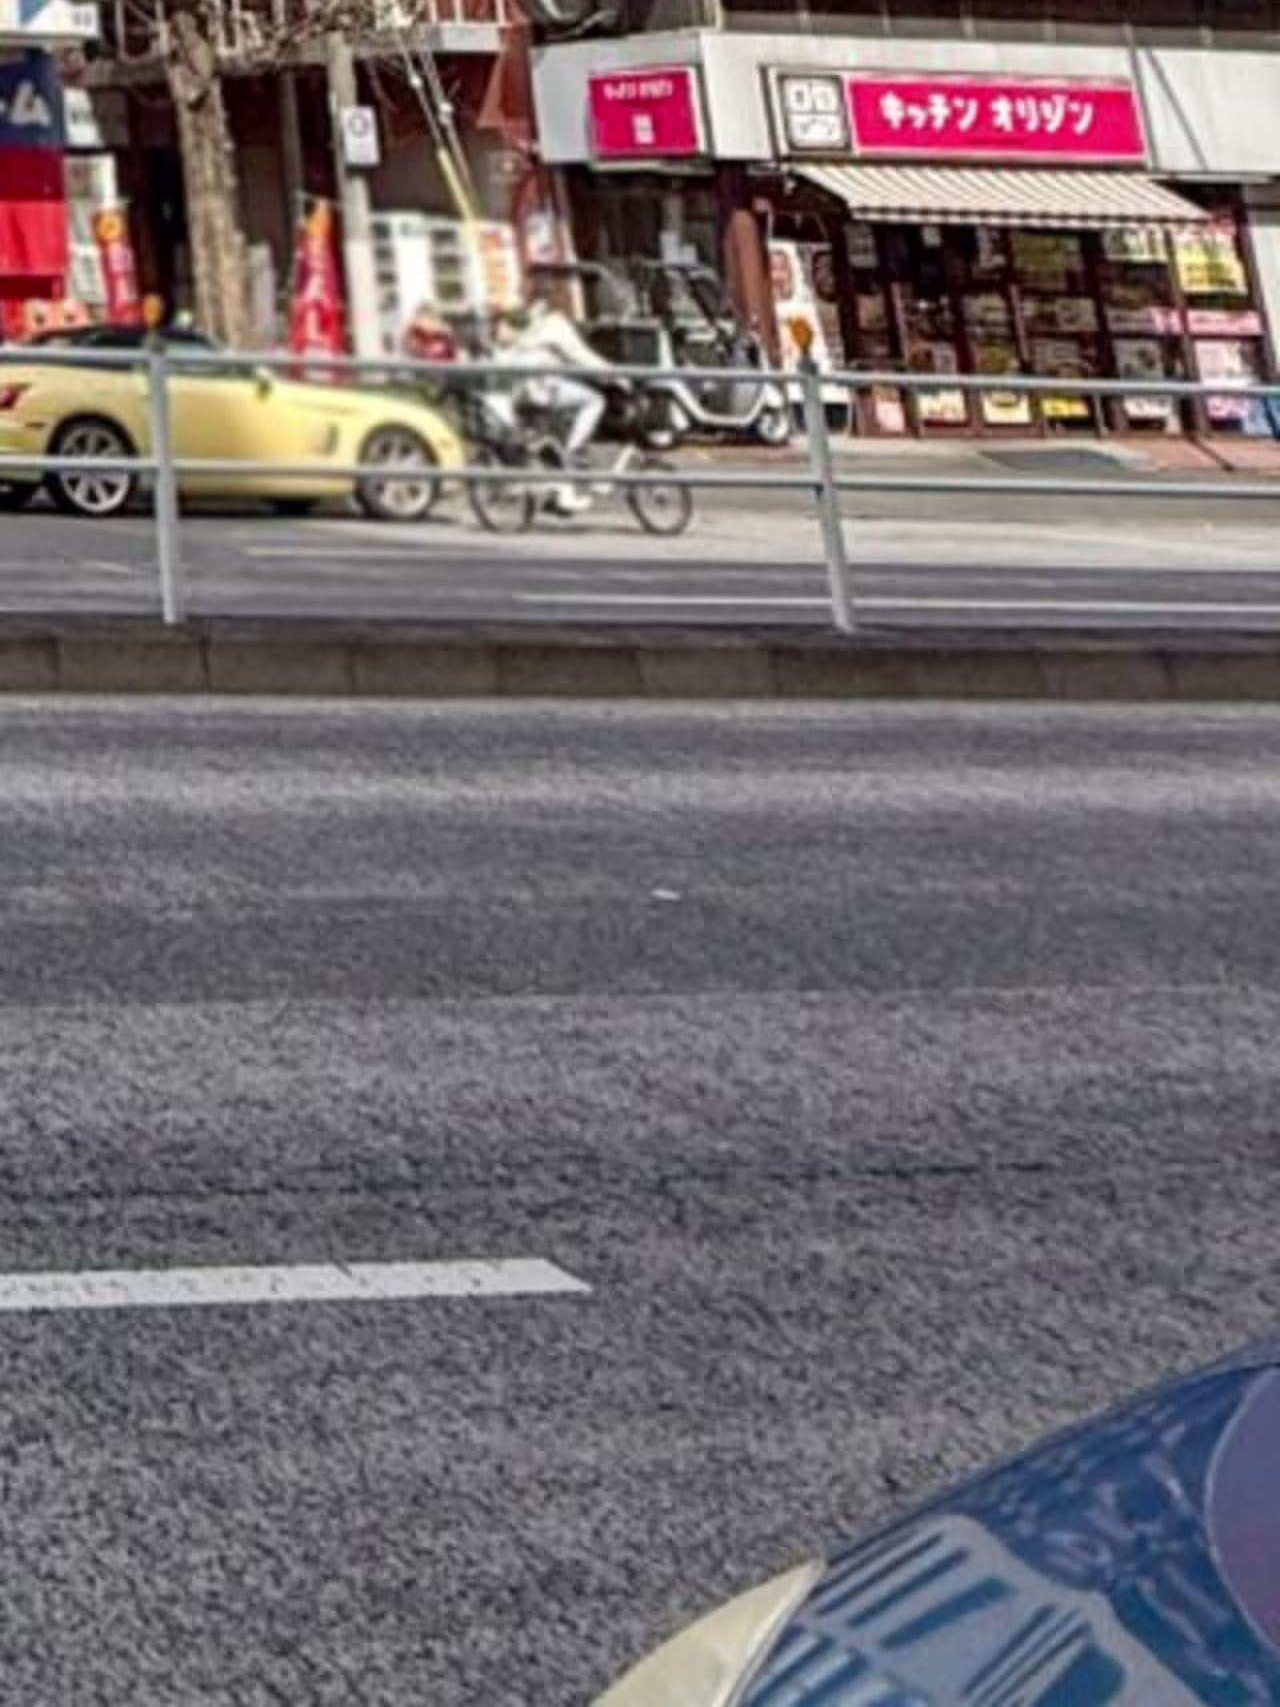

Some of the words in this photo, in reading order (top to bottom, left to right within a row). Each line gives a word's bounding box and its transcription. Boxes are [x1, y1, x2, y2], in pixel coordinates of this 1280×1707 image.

[880, 90, 978, 132] キッチン
[991, 95, 1094, 135] オリジン
